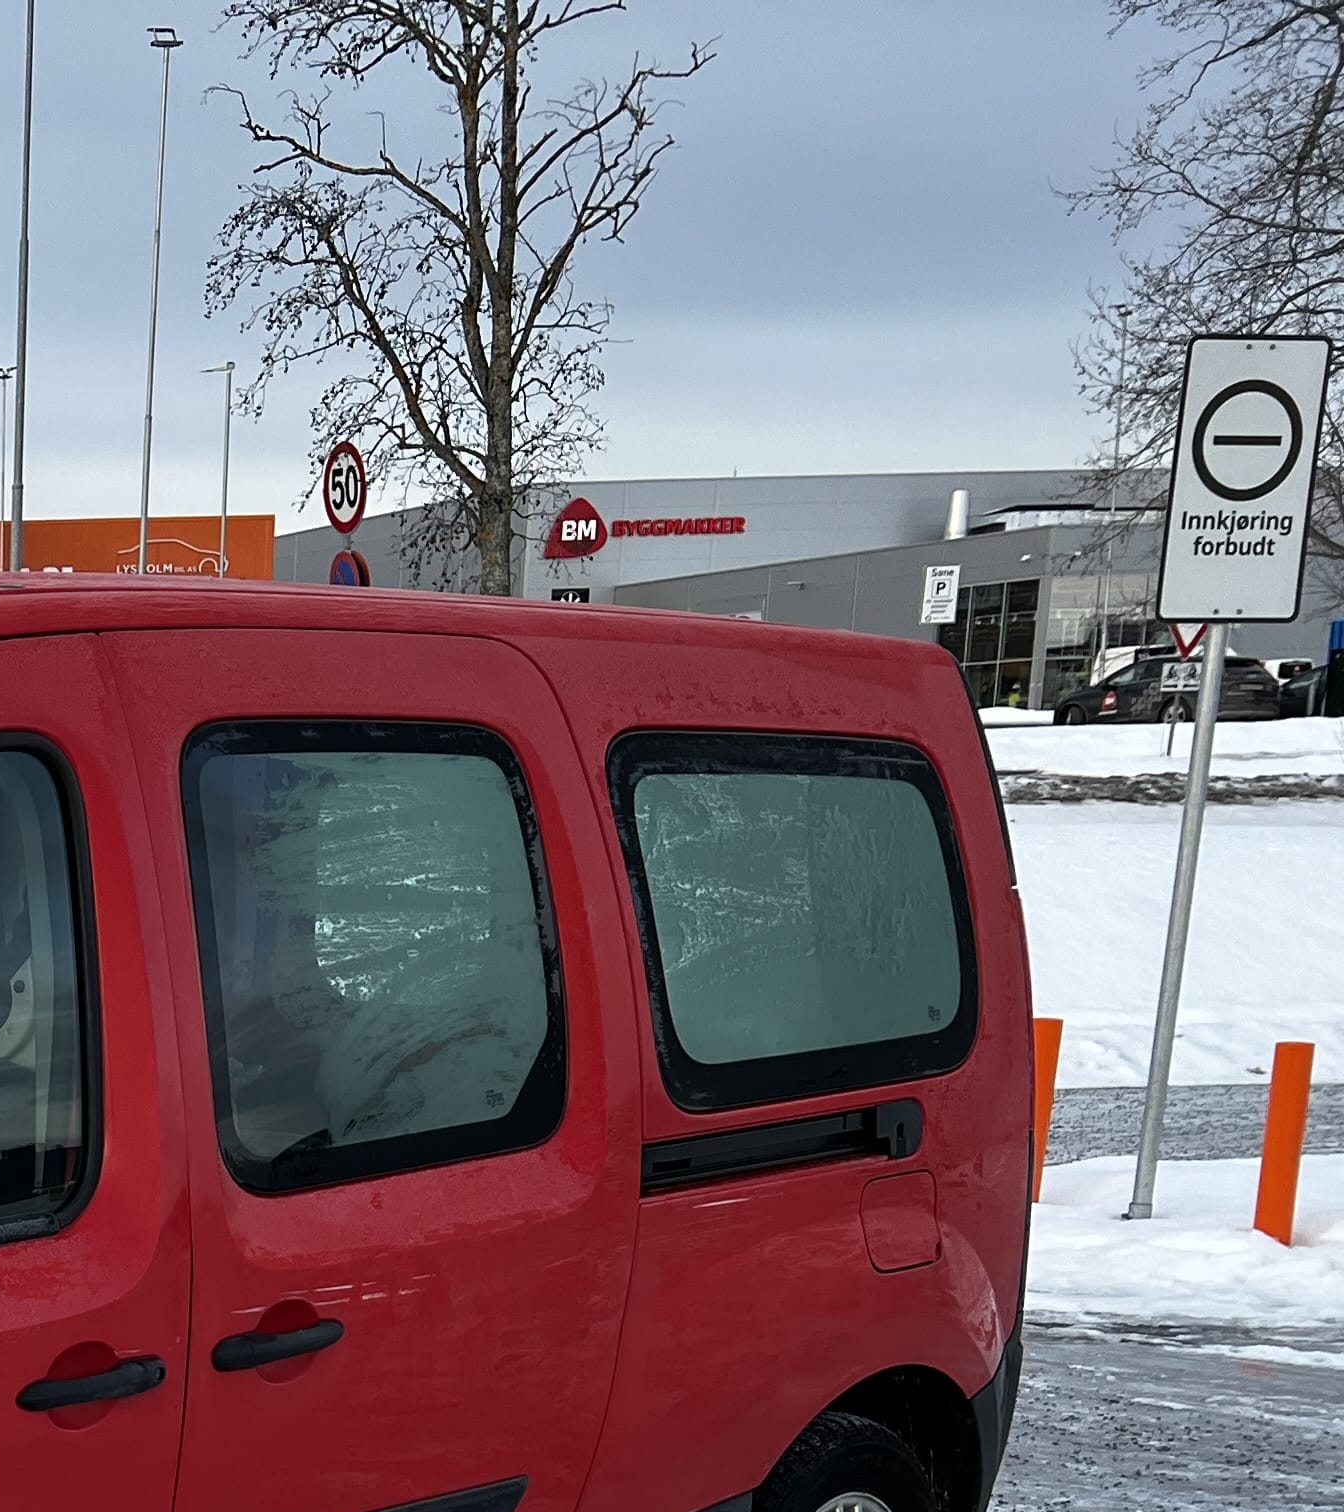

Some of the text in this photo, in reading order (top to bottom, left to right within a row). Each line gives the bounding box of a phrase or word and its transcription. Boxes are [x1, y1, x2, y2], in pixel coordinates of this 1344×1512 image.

[332, 465, 358, 511] 50
[561, 517, 746, 541] BM BYGGMAKKER
[1181, 510, 1293, 536] Innkjøring
[1193, 536, 1276, 556] forbudt
[116, 564, 172, 575] LYSOLM
[936, 582, 946, 595] P
